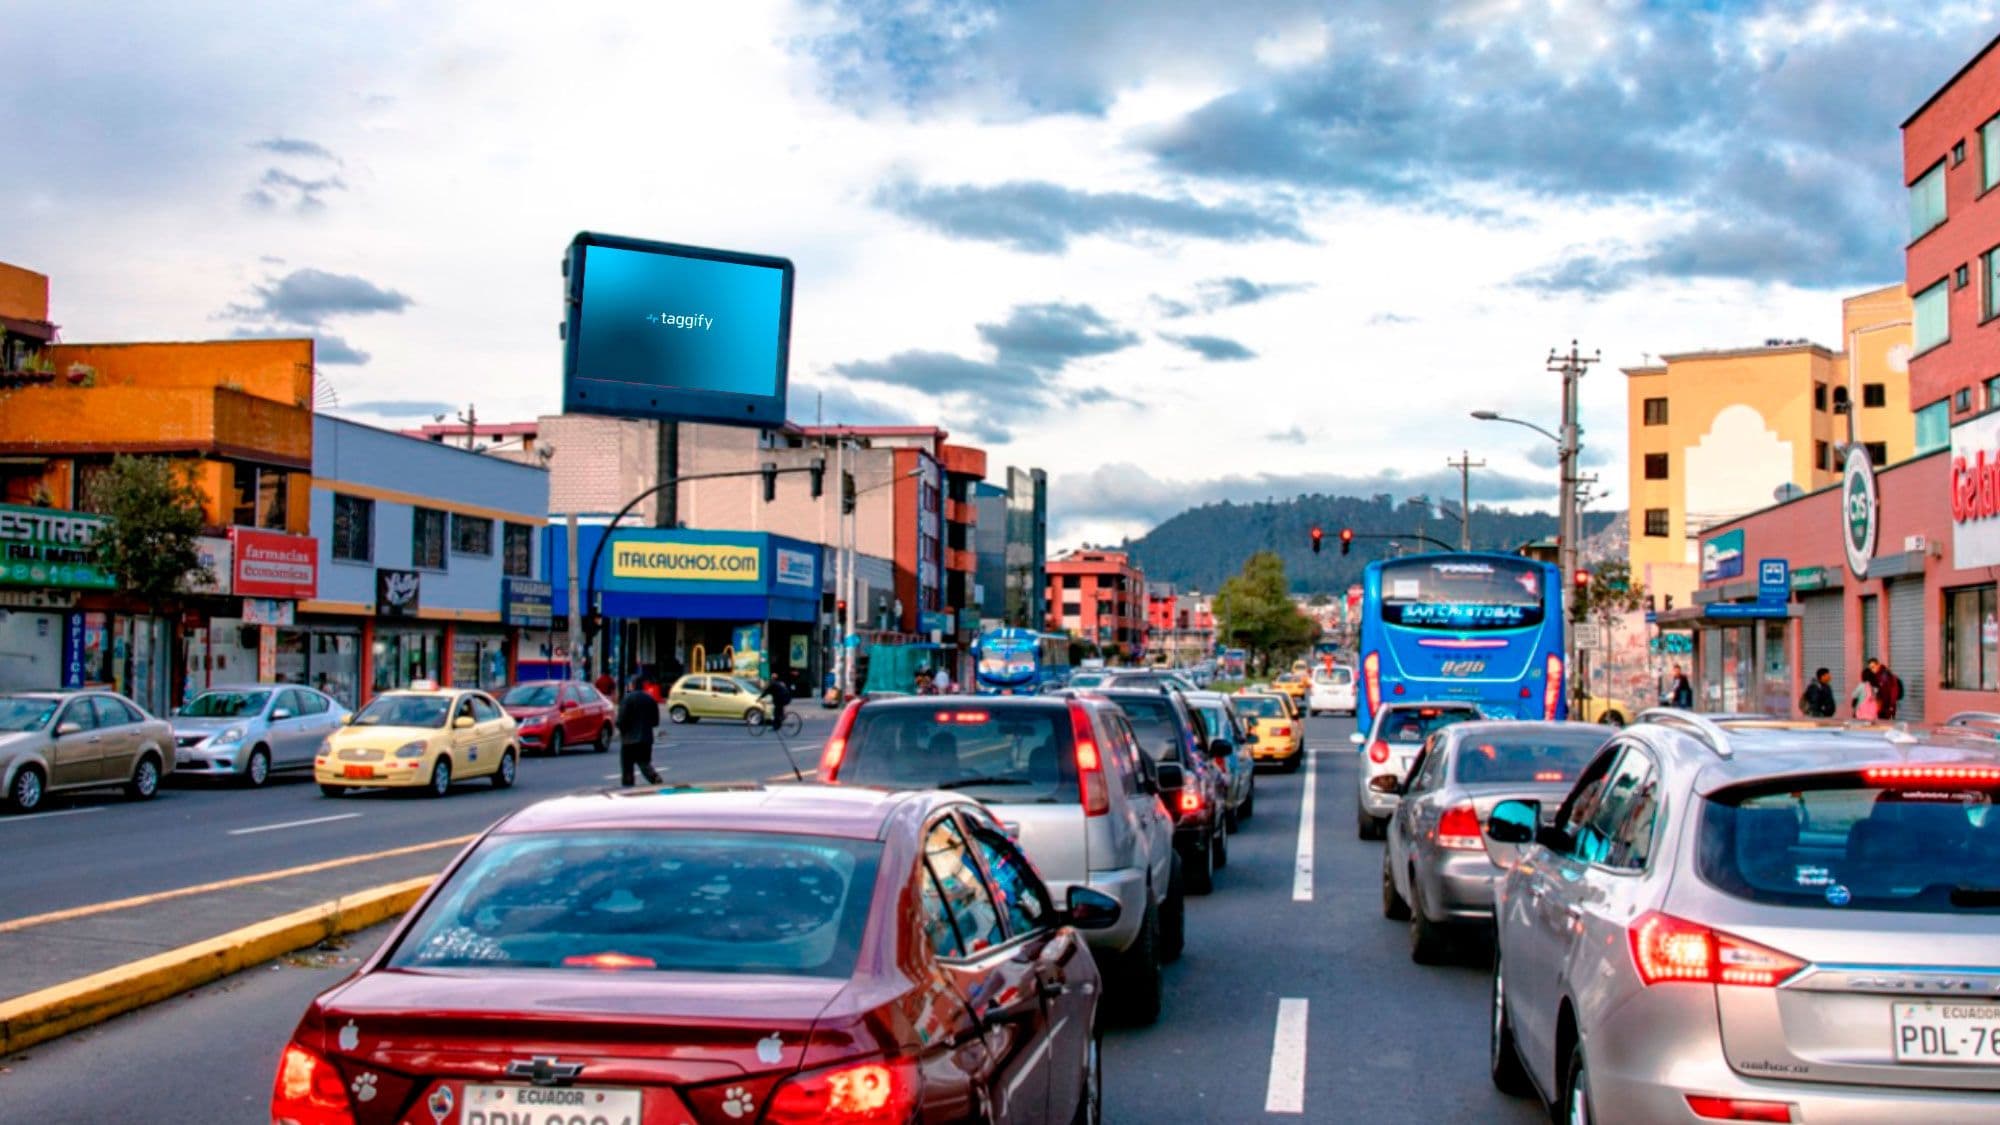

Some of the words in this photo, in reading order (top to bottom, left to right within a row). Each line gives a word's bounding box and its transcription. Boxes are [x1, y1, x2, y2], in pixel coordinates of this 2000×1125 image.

[661, 312, 713, 330] taggify
[245, 544, 309, 563] farmacias
[517, 1089, 584, 1104] ECUADOR
